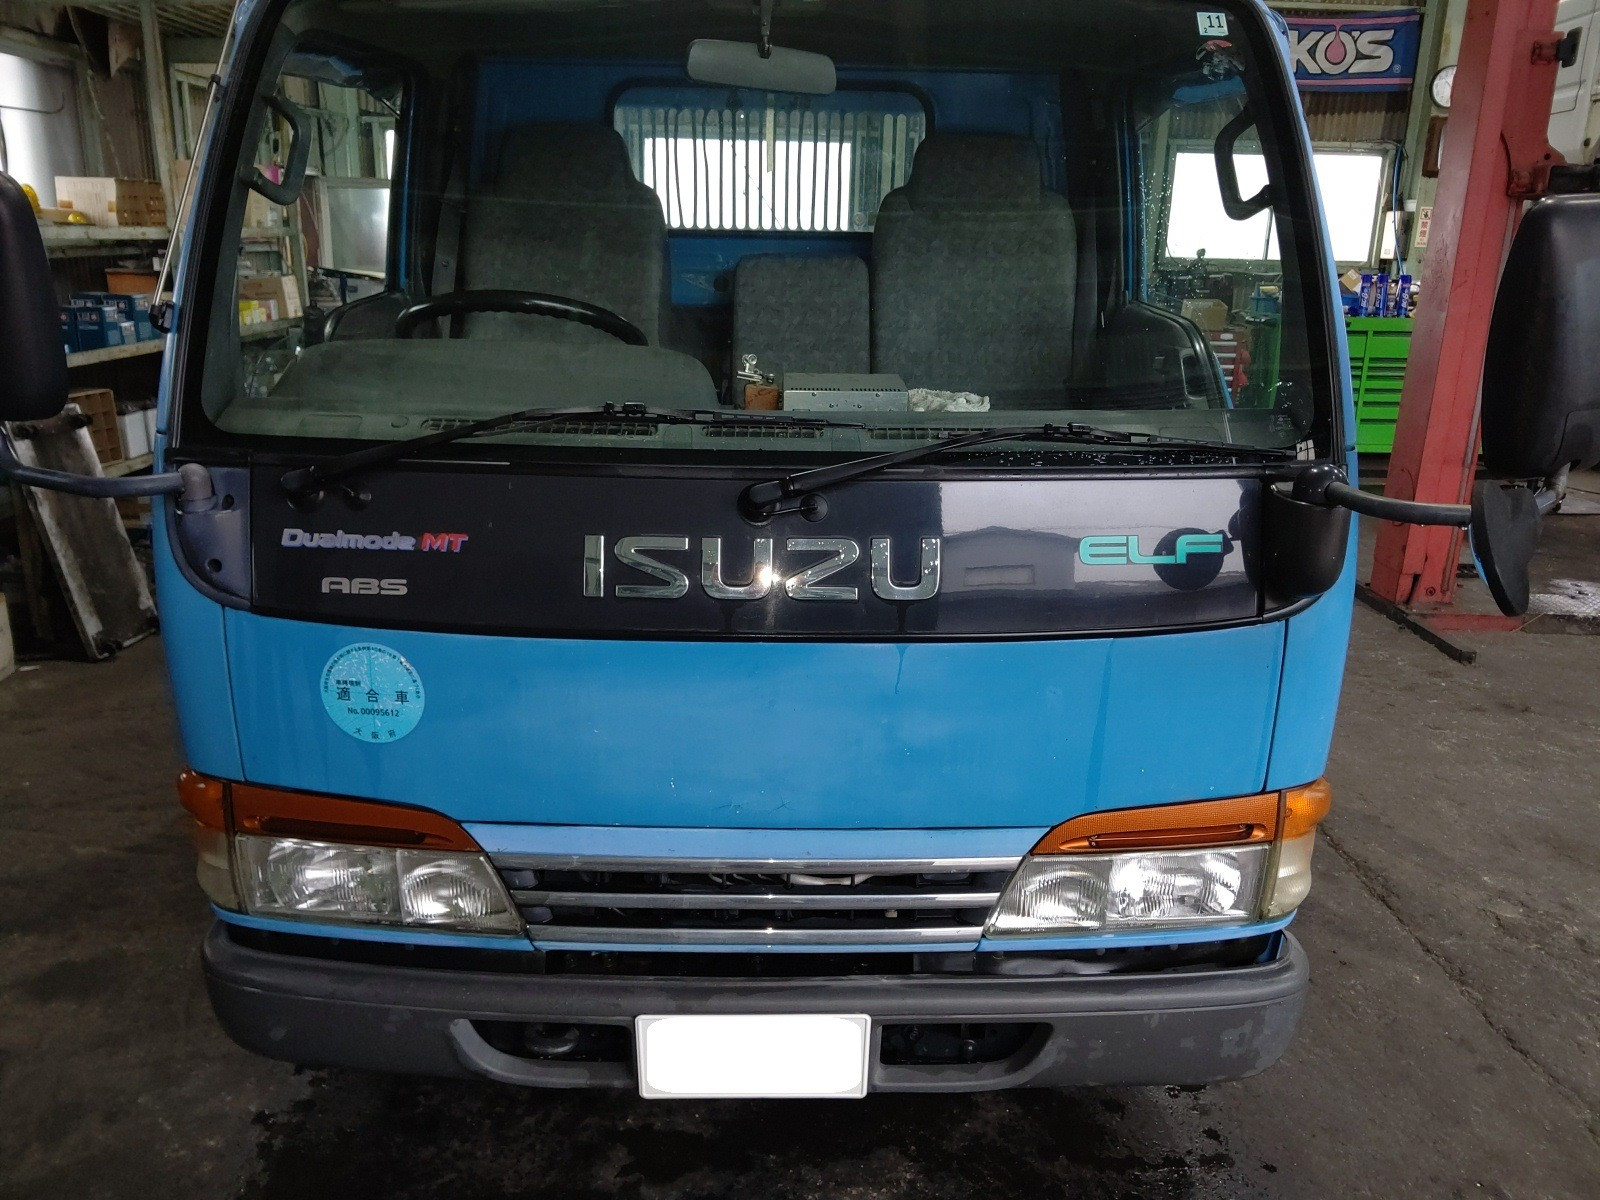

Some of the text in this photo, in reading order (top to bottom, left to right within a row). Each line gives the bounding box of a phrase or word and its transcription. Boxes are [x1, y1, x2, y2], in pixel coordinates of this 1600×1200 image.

[1206, 14, 1224, 28] 11
[281, 528, 469, 553] Dualmode MT
[1079, 533, 1224, 566] ELF
[583, 534, 941, 601] ISUZU
[321, 576, 408, 596] ABS
[336, 686, 410, 705] 適合車
